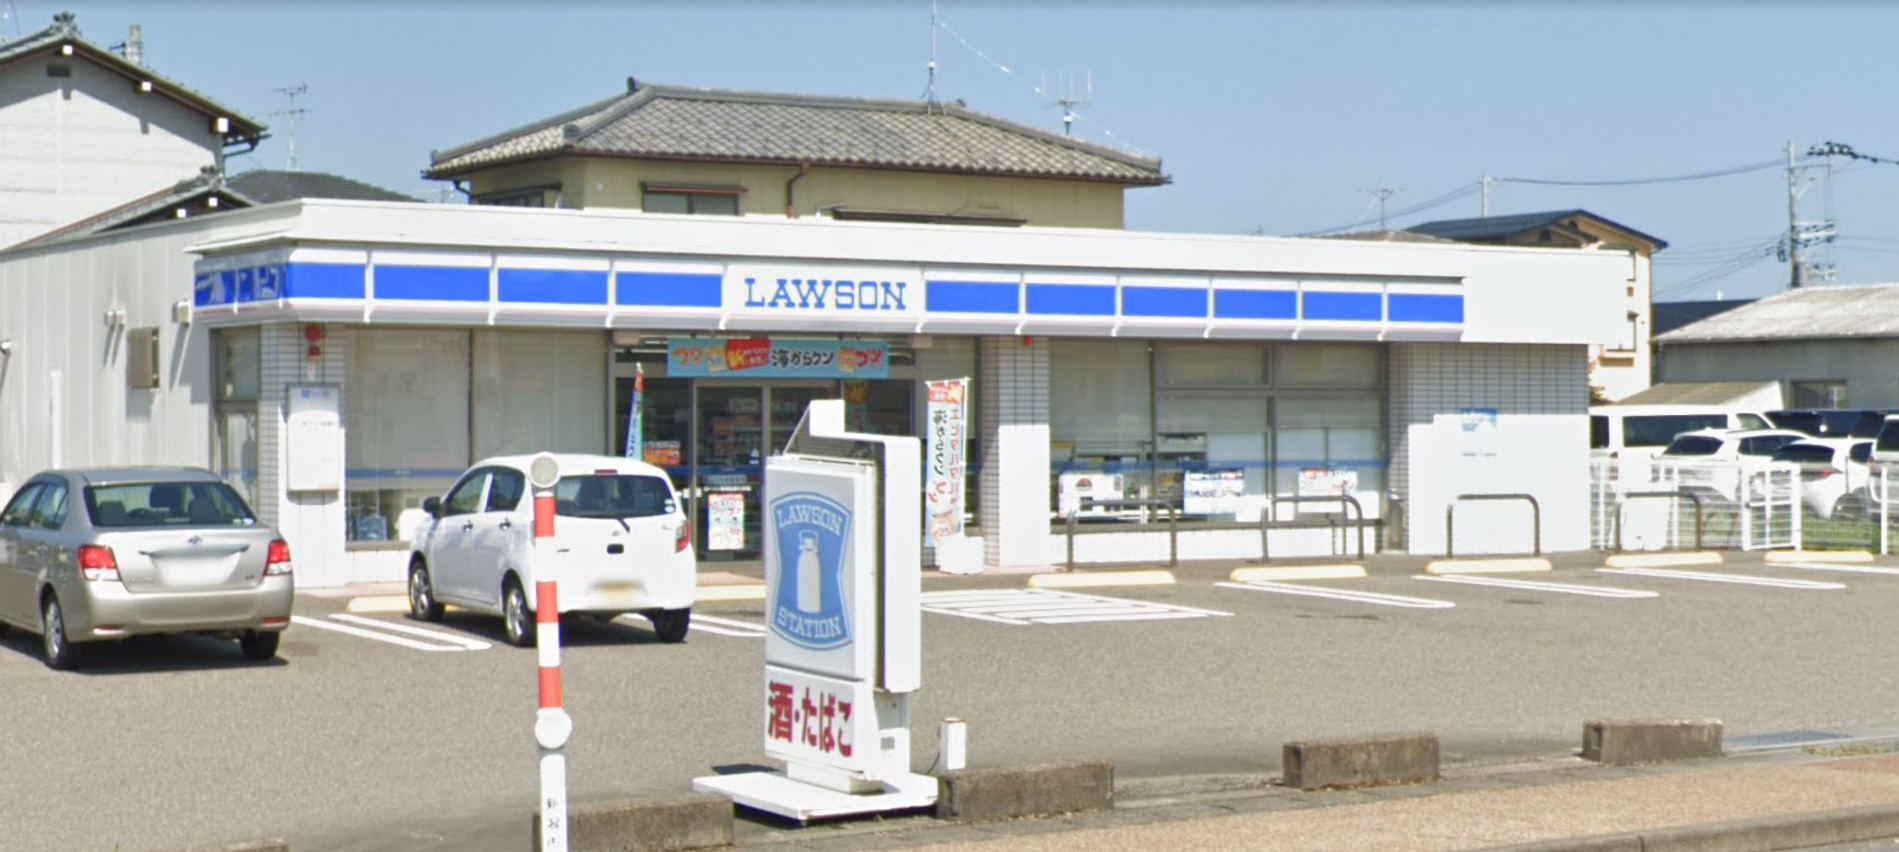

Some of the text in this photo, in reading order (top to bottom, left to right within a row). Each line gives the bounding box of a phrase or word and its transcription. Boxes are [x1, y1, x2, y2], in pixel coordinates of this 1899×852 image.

[744, 278, 906, 310] LAWSON
[771, 348, 834, 368] 海からクン
[777, 506, 842, 536] LAWSON
[777, 607, 841, 638] STATION
[767, 680, 853, 758] 酒・たばこ
